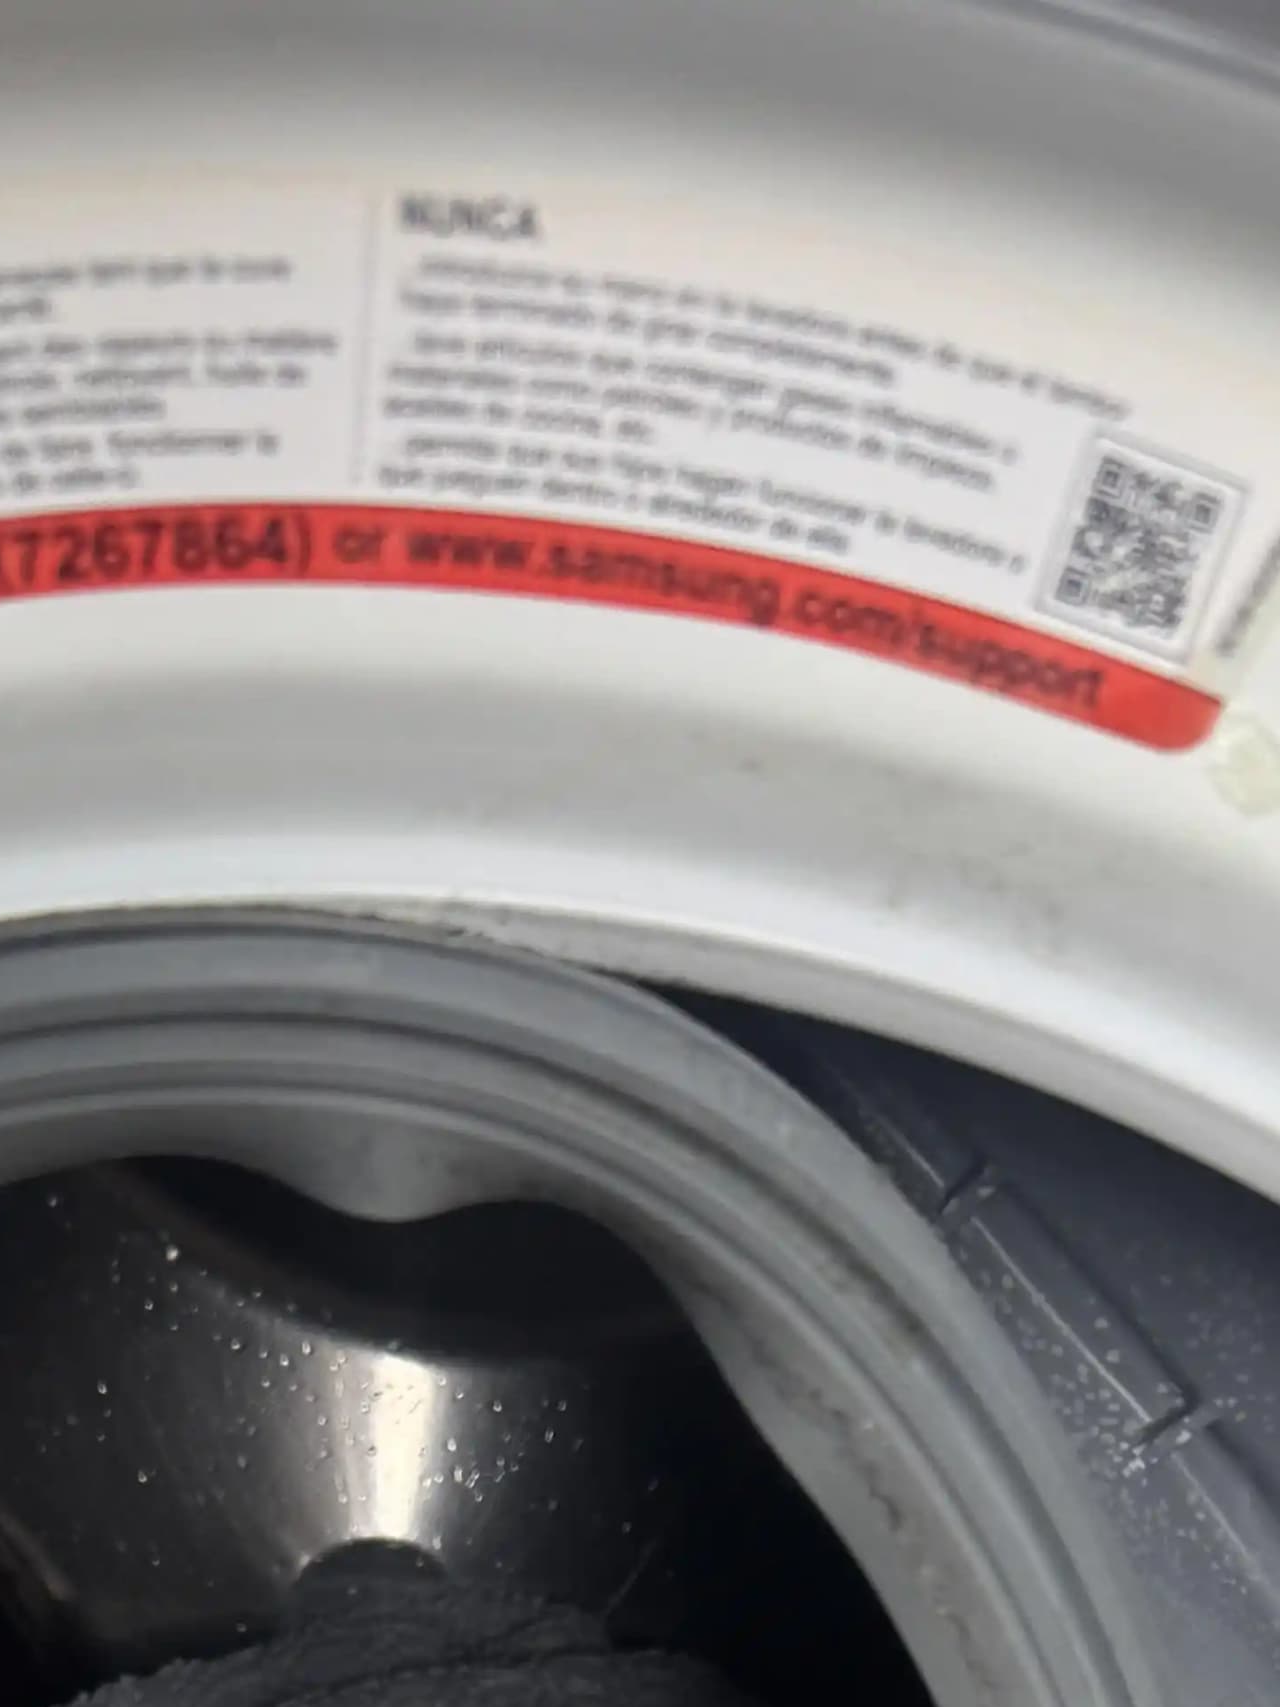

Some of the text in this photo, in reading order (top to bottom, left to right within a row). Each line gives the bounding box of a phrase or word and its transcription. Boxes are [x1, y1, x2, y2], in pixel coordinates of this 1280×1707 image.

[399, 194, 542, 243] NUNCA
[333, 524, 388, 564] or
[404, 532, 1106, 710] www.samsung.com/support
